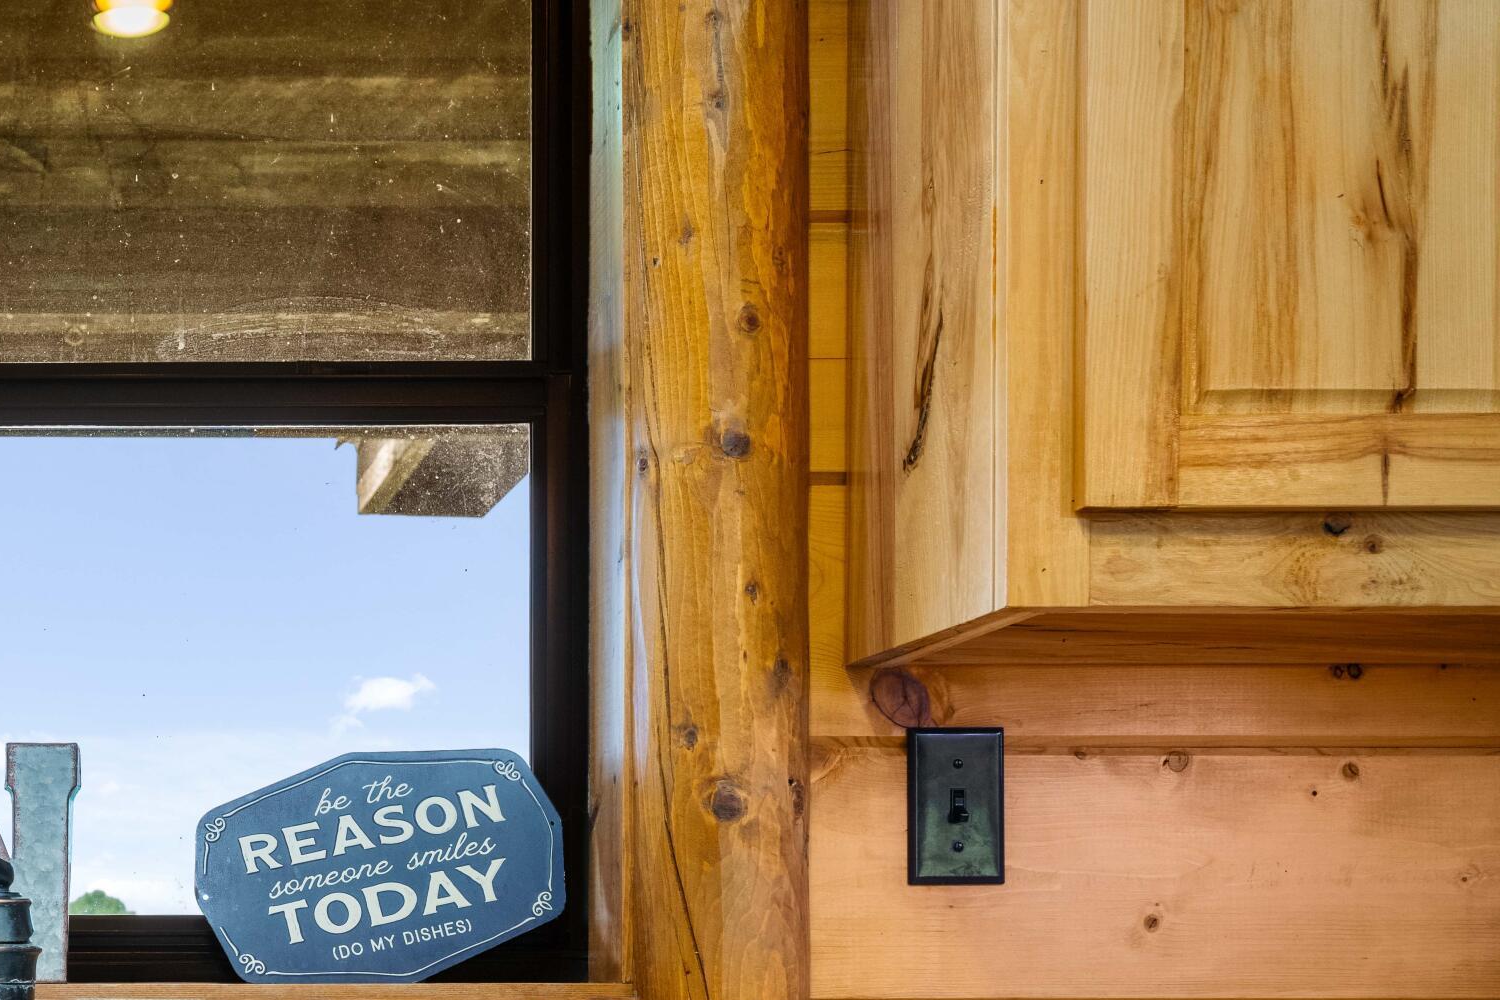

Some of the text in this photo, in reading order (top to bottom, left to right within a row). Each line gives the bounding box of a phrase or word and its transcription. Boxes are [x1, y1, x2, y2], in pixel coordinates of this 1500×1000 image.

[238, 784, 507, 875] REASON
[313, 775, 414, 817] be the
[268, 831, 497, 899] someone smiles
[267, 857, 507, 945] TODAY
[332, 917, 473, 961] (DO MY DISHES)
